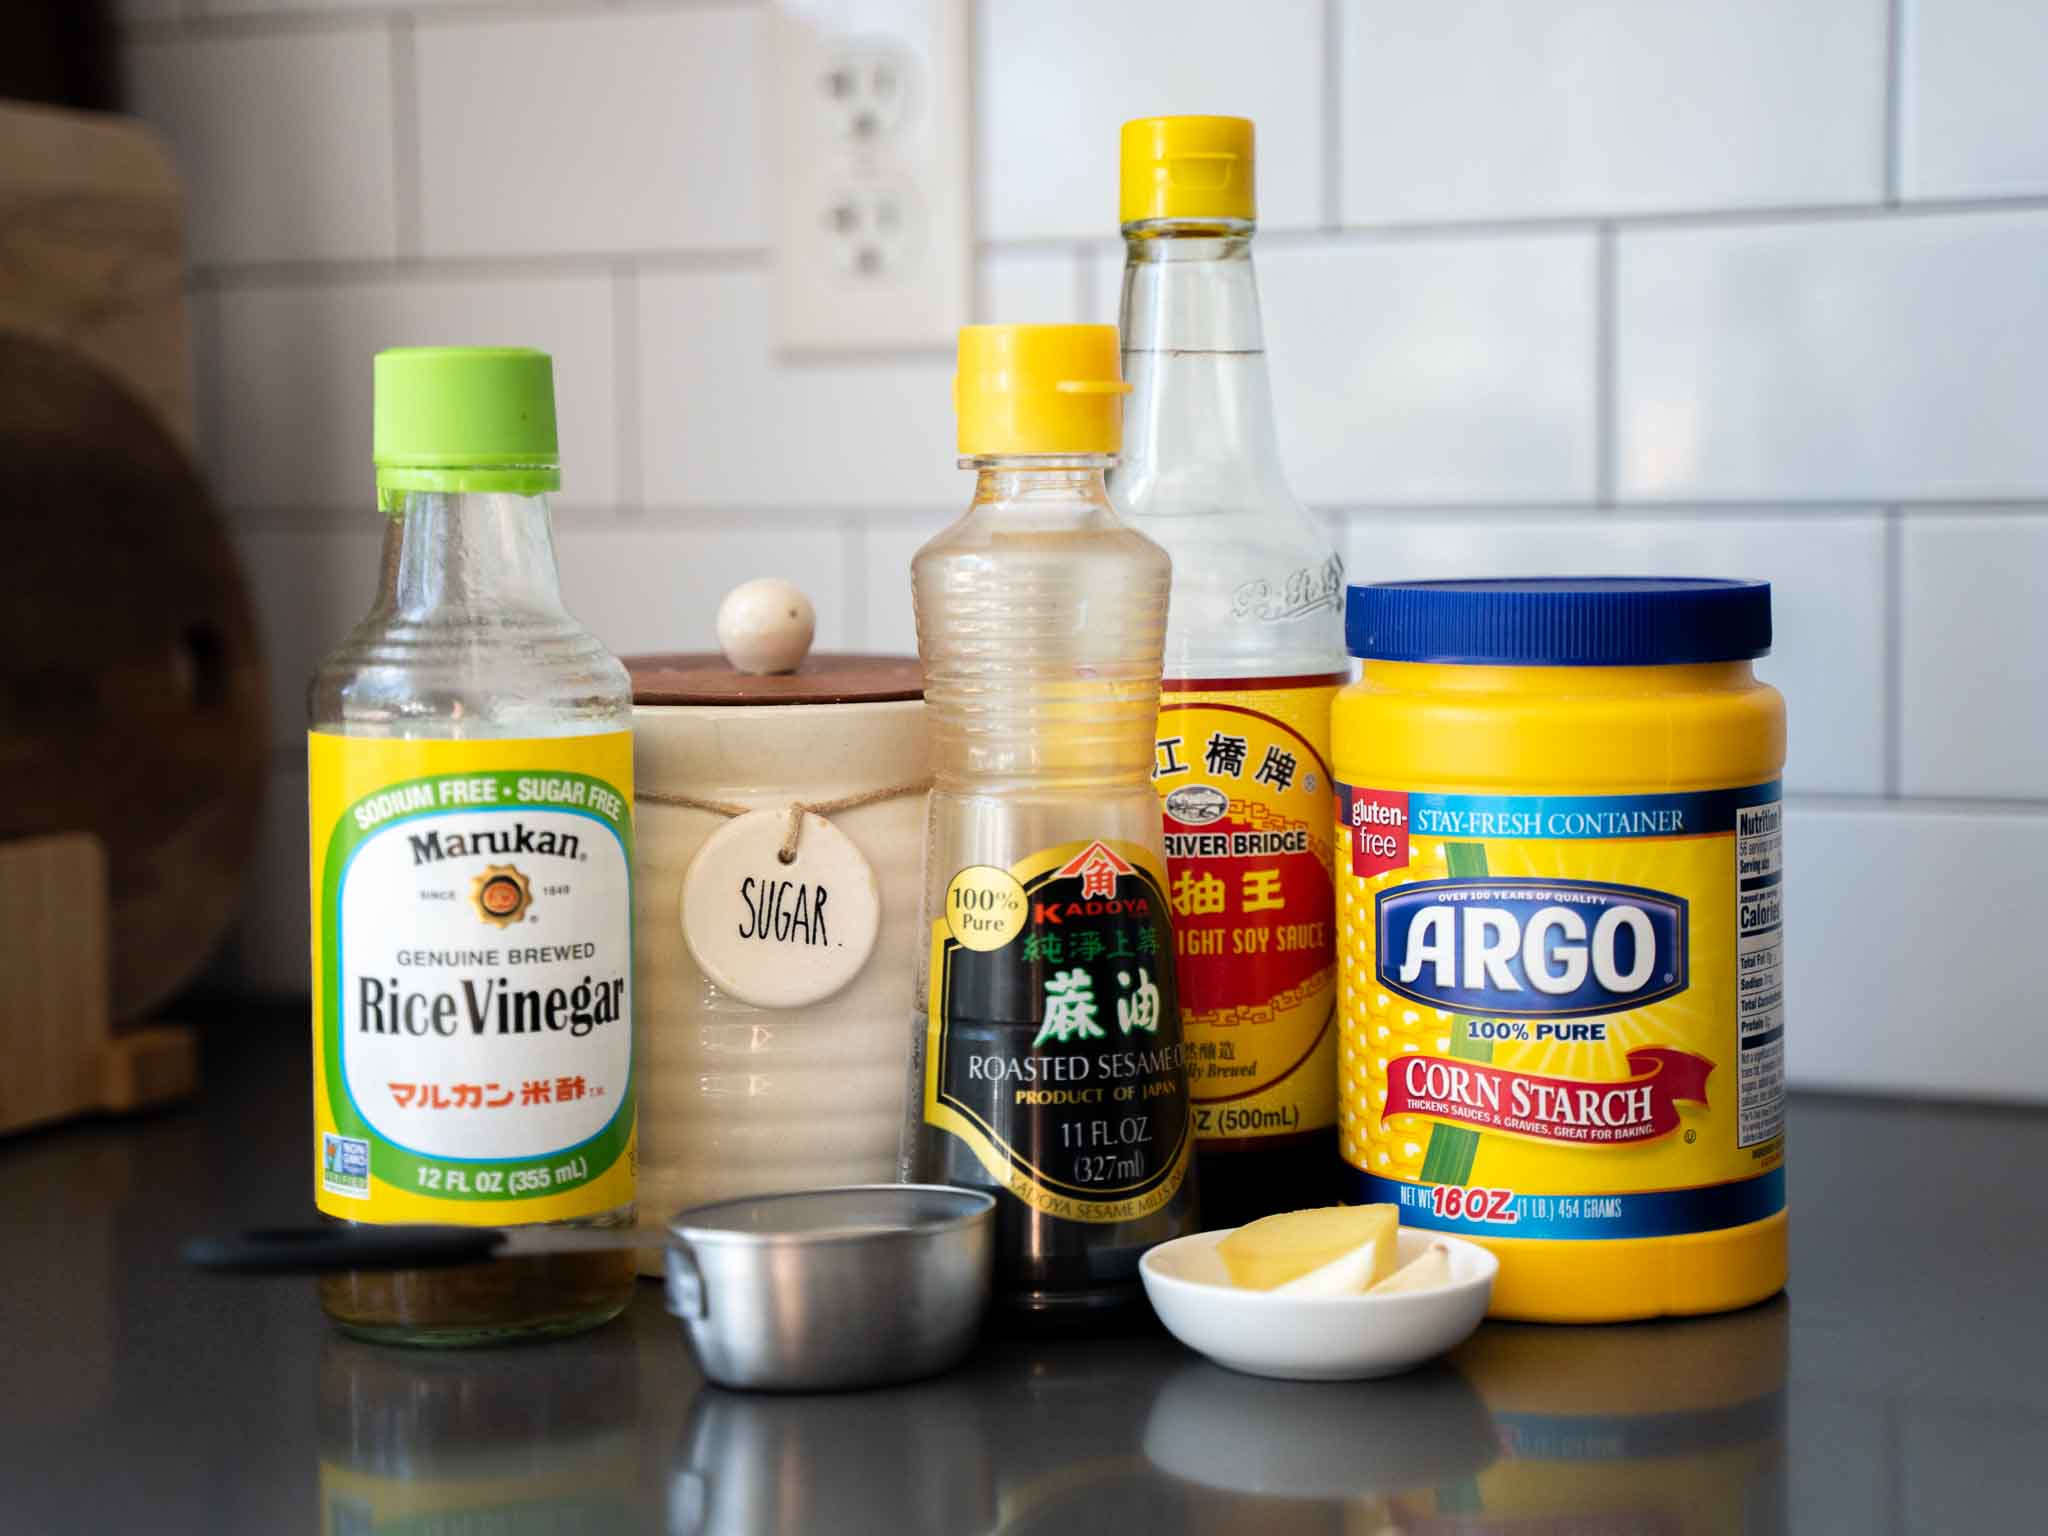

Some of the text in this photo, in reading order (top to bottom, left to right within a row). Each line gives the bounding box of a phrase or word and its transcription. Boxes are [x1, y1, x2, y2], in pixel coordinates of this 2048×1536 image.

[354, 776, 621, 830] SODIUM FREE SUGAR FREE
[1352, 799, 1407, 826] gluten-
[1418, 809, 1686, 835] STAY-FRESH CONTAINER
[408, 824, 580, 866] Marukan
[1233, 831, 1307, 856] BRIDGE
[1359, 829, 1397, 857] free
[953, 888, 1019, 911] 100%
[1172, 868, 1286, 917] 抽王
[1439, 892, 1608, 905] OVER 100 YEARS OF QUALITY
[963, 914, 1005, 931] Pure
[1033, 898, 1149, 925] KADOYA
[1178, 922, 1326, 956] IGHT SOY SAUCE
[1399, 905, 1657, 995] ARGO
[397, 943, 596, 967] GENUINE BREWED
[358, 976, 625, 1037] Rice Vinegar
[1467, 1021, 1606, 1041] 100% PURE
[968, 1055, 1089, 1081] ROASTED
[387, 1076, 589, 1109] マルカン 米酢
[1015, 1080, 1176, 1105] PRODUCT OF JAPAN
[1405, 1058, 1654, 1127] CORN STARCH
[1218, 1104, 1300, 1135] (500mL)
[1407, 1098, 1450, 1114] THICKENS
[1450, 1106, 1491, 1123] SAUCES
[1493, 1116, 1501, 1126] &
[1554, 1126, 1588, 1139] GREAT
[1591, 1127, 1612, 1140] FOR
[1061, 1122, 1082, 1148] 11
[417, 1157, 588, 1196] 12 FL OZ (355 mL)
[1074, 1150, 1145, 1182] (327ml)
[1077, 1201, 1135, 1218] SESAME
[1400, 1186, 1416, 1206] NET
[1558, 1198, 1578, 1218] 454
[1583, 1197, 1622, 1218] GRAMS
